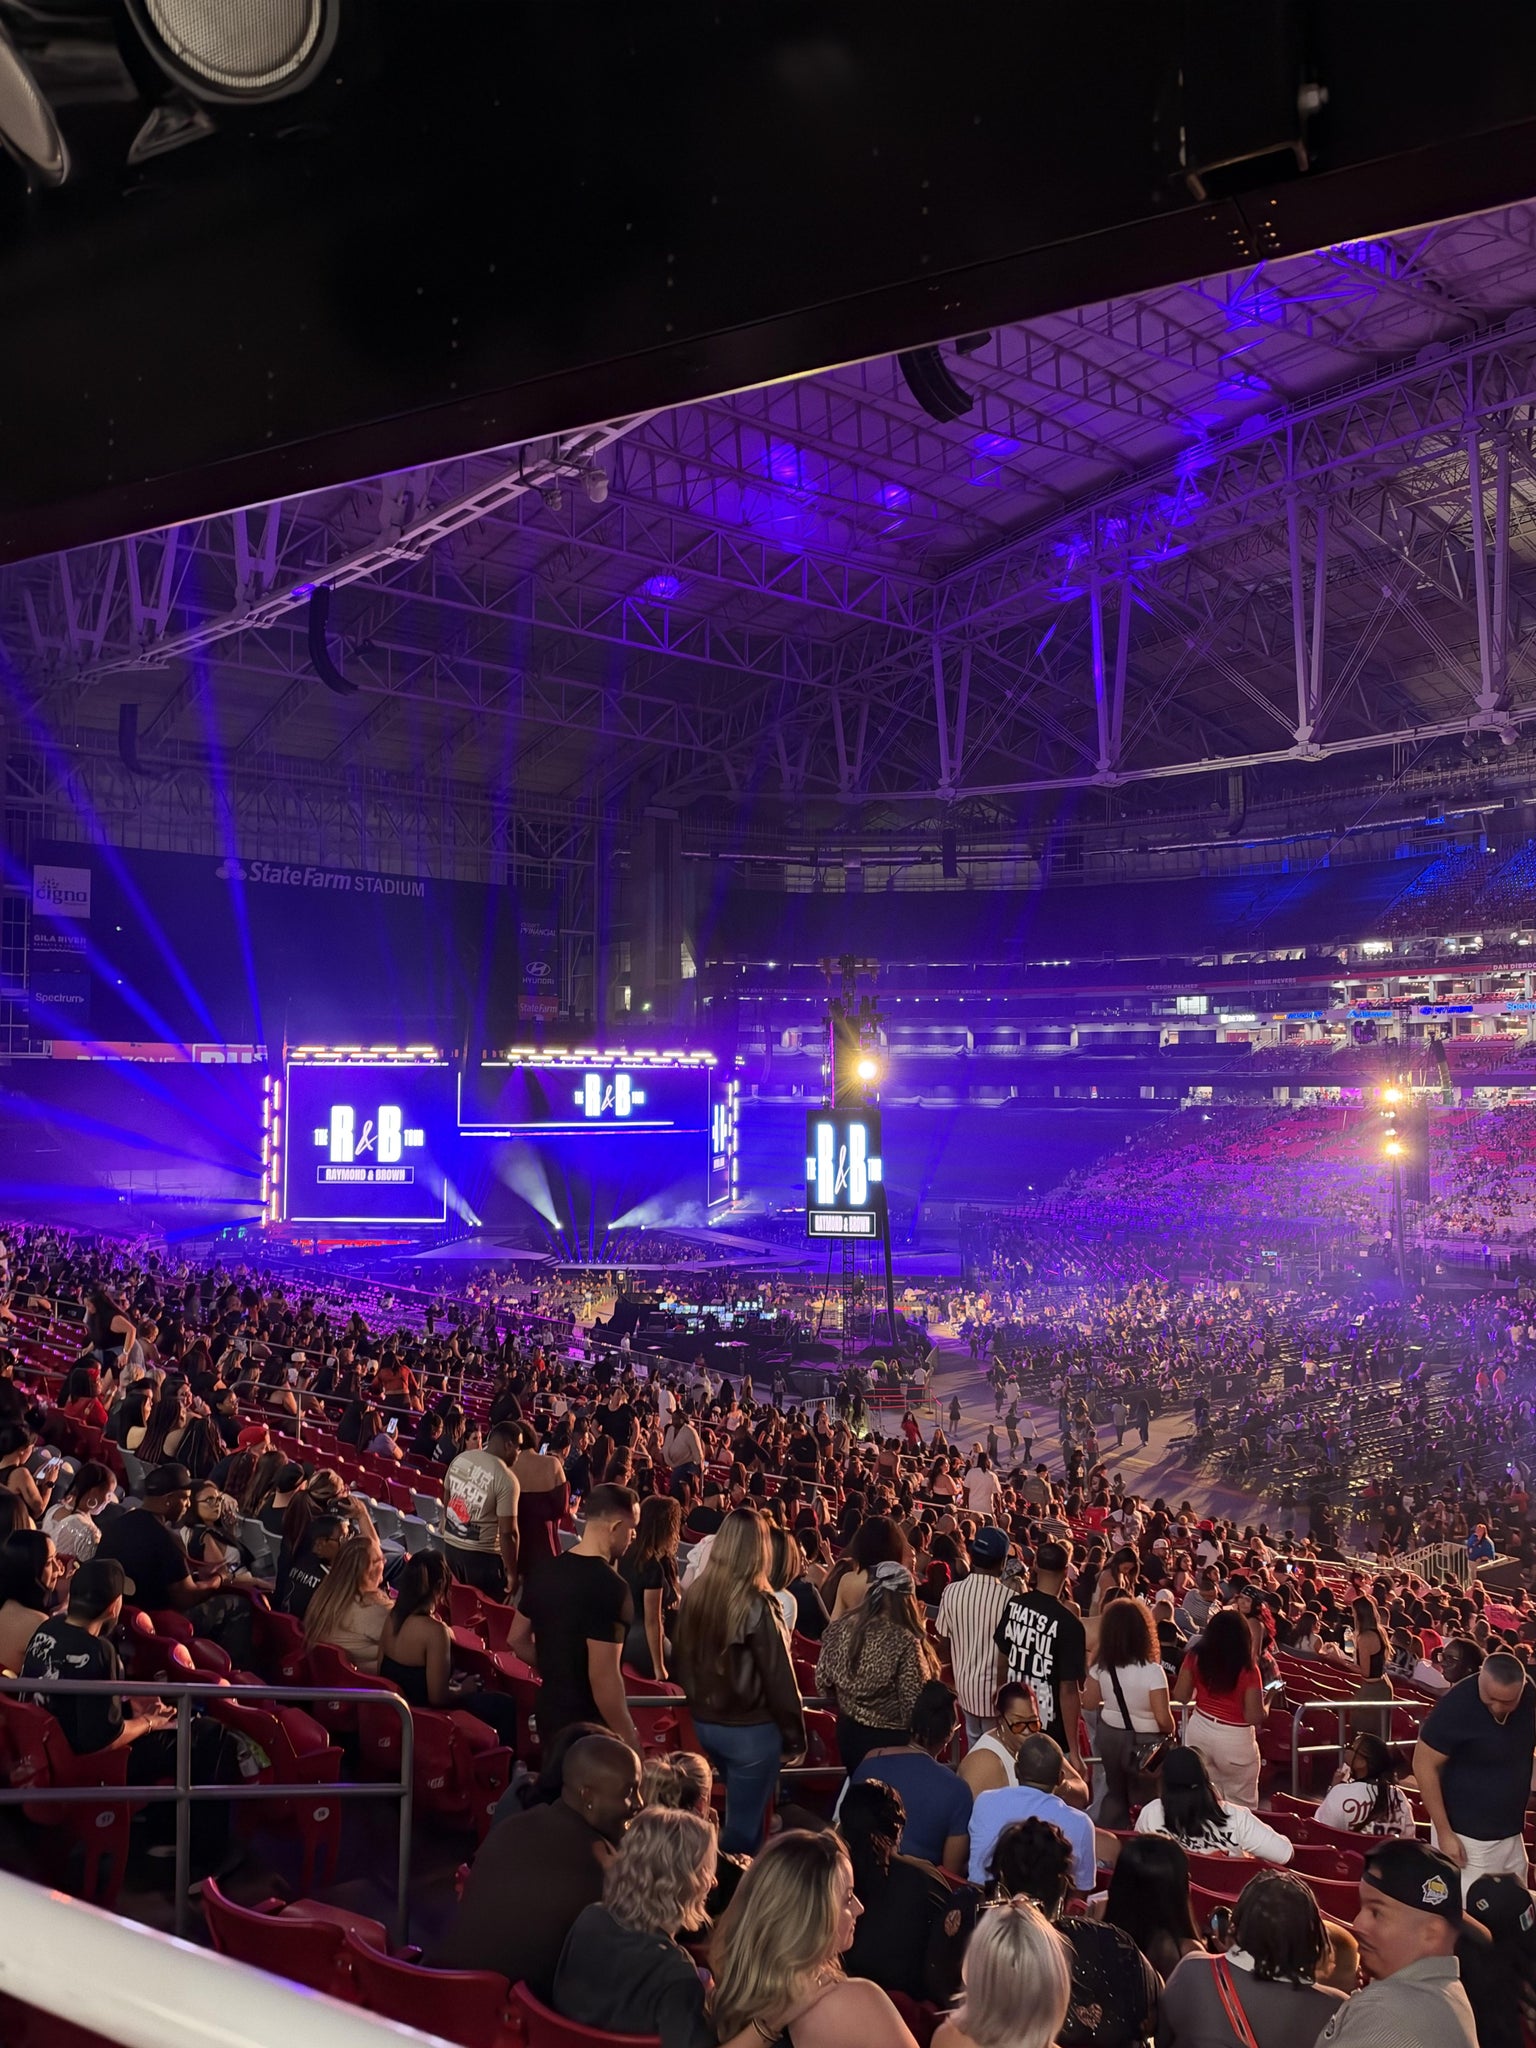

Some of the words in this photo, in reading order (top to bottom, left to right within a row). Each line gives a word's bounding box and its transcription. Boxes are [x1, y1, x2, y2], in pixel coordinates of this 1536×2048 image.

[354, 876, 425, 897] STADIUM
[34, 934, 56, 942] GILA
[35, 992, 82, 1004] Spectrum
[330, 1105, 402, 1163] R&B
[326, 1168, 366, 1181] RAYMOND
[367, 1169, 374, 1181] &
[376, 1169, 406, 1181] BROWN
[1225, 1380, 1233, 1393] P
[1009, 1602, 1048, 1633] THAT'S
[1047, 1620, 1058, 1638] A
[1004, 1620, 1053, 1660] AWFUL
[1008, 1644, 1030, 1671] OT
